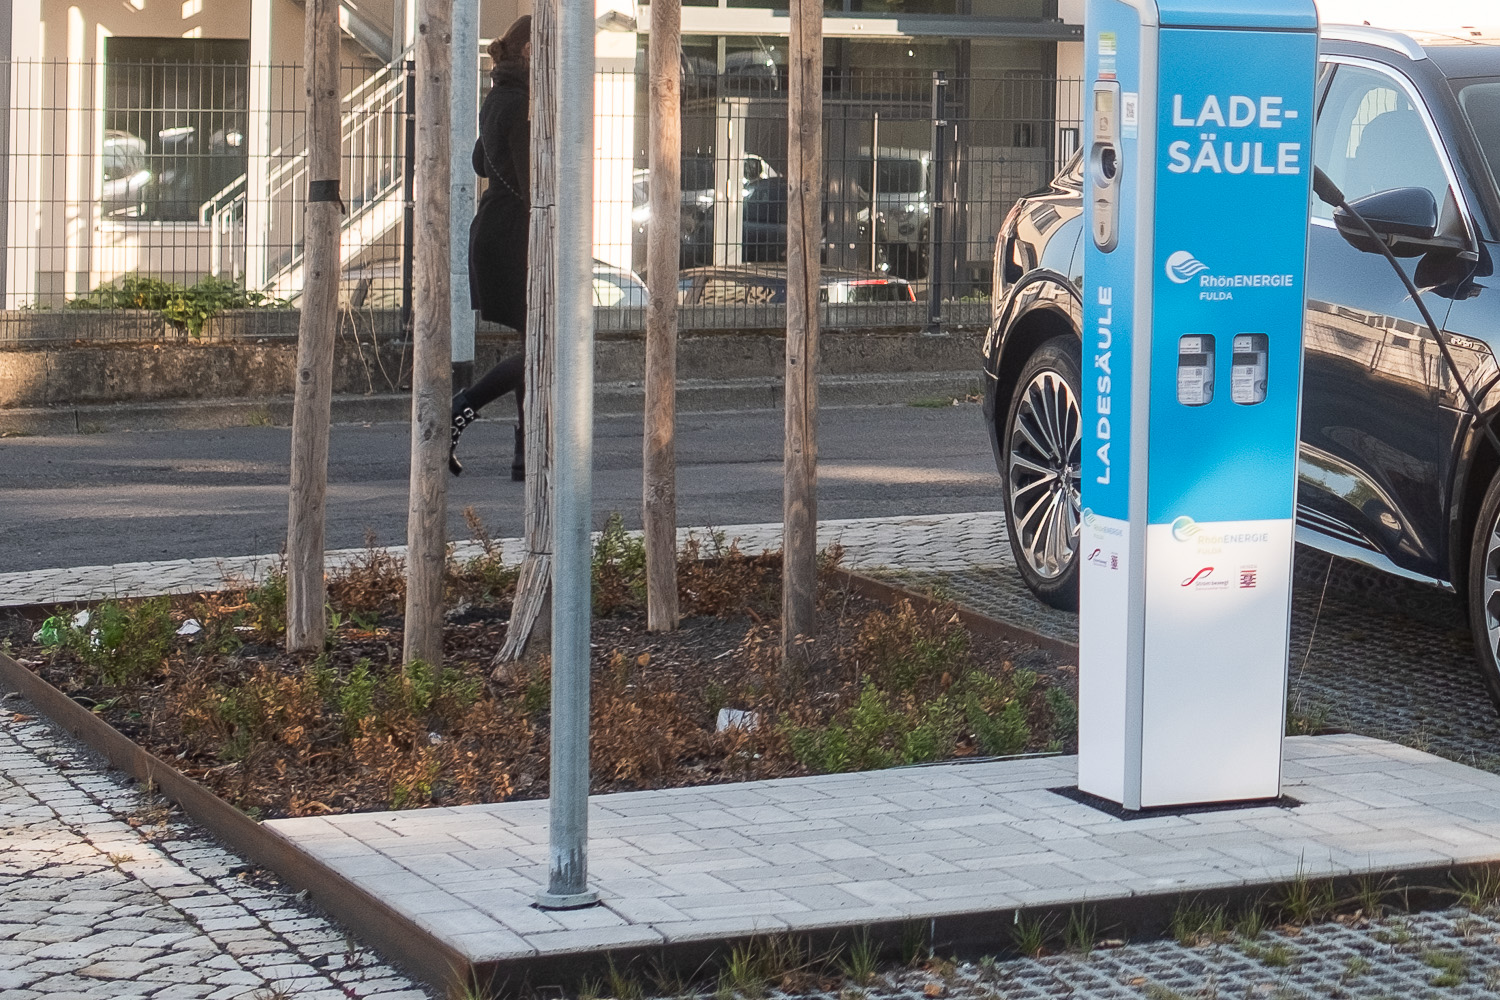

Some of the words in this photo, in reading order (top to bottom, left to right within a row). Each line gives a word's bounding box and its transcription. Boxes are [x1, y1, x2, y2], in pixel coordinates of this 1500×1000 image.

[1173, 94, 1298, 128] LADE-
[1167, 133, 1301, 175] SÄULE
[1200, 274, 1294, 287] RhönENERGIE
[1200, 291, 1234, 301] FULDA
[1096, 285, 1113, 486] LADESÄULE
